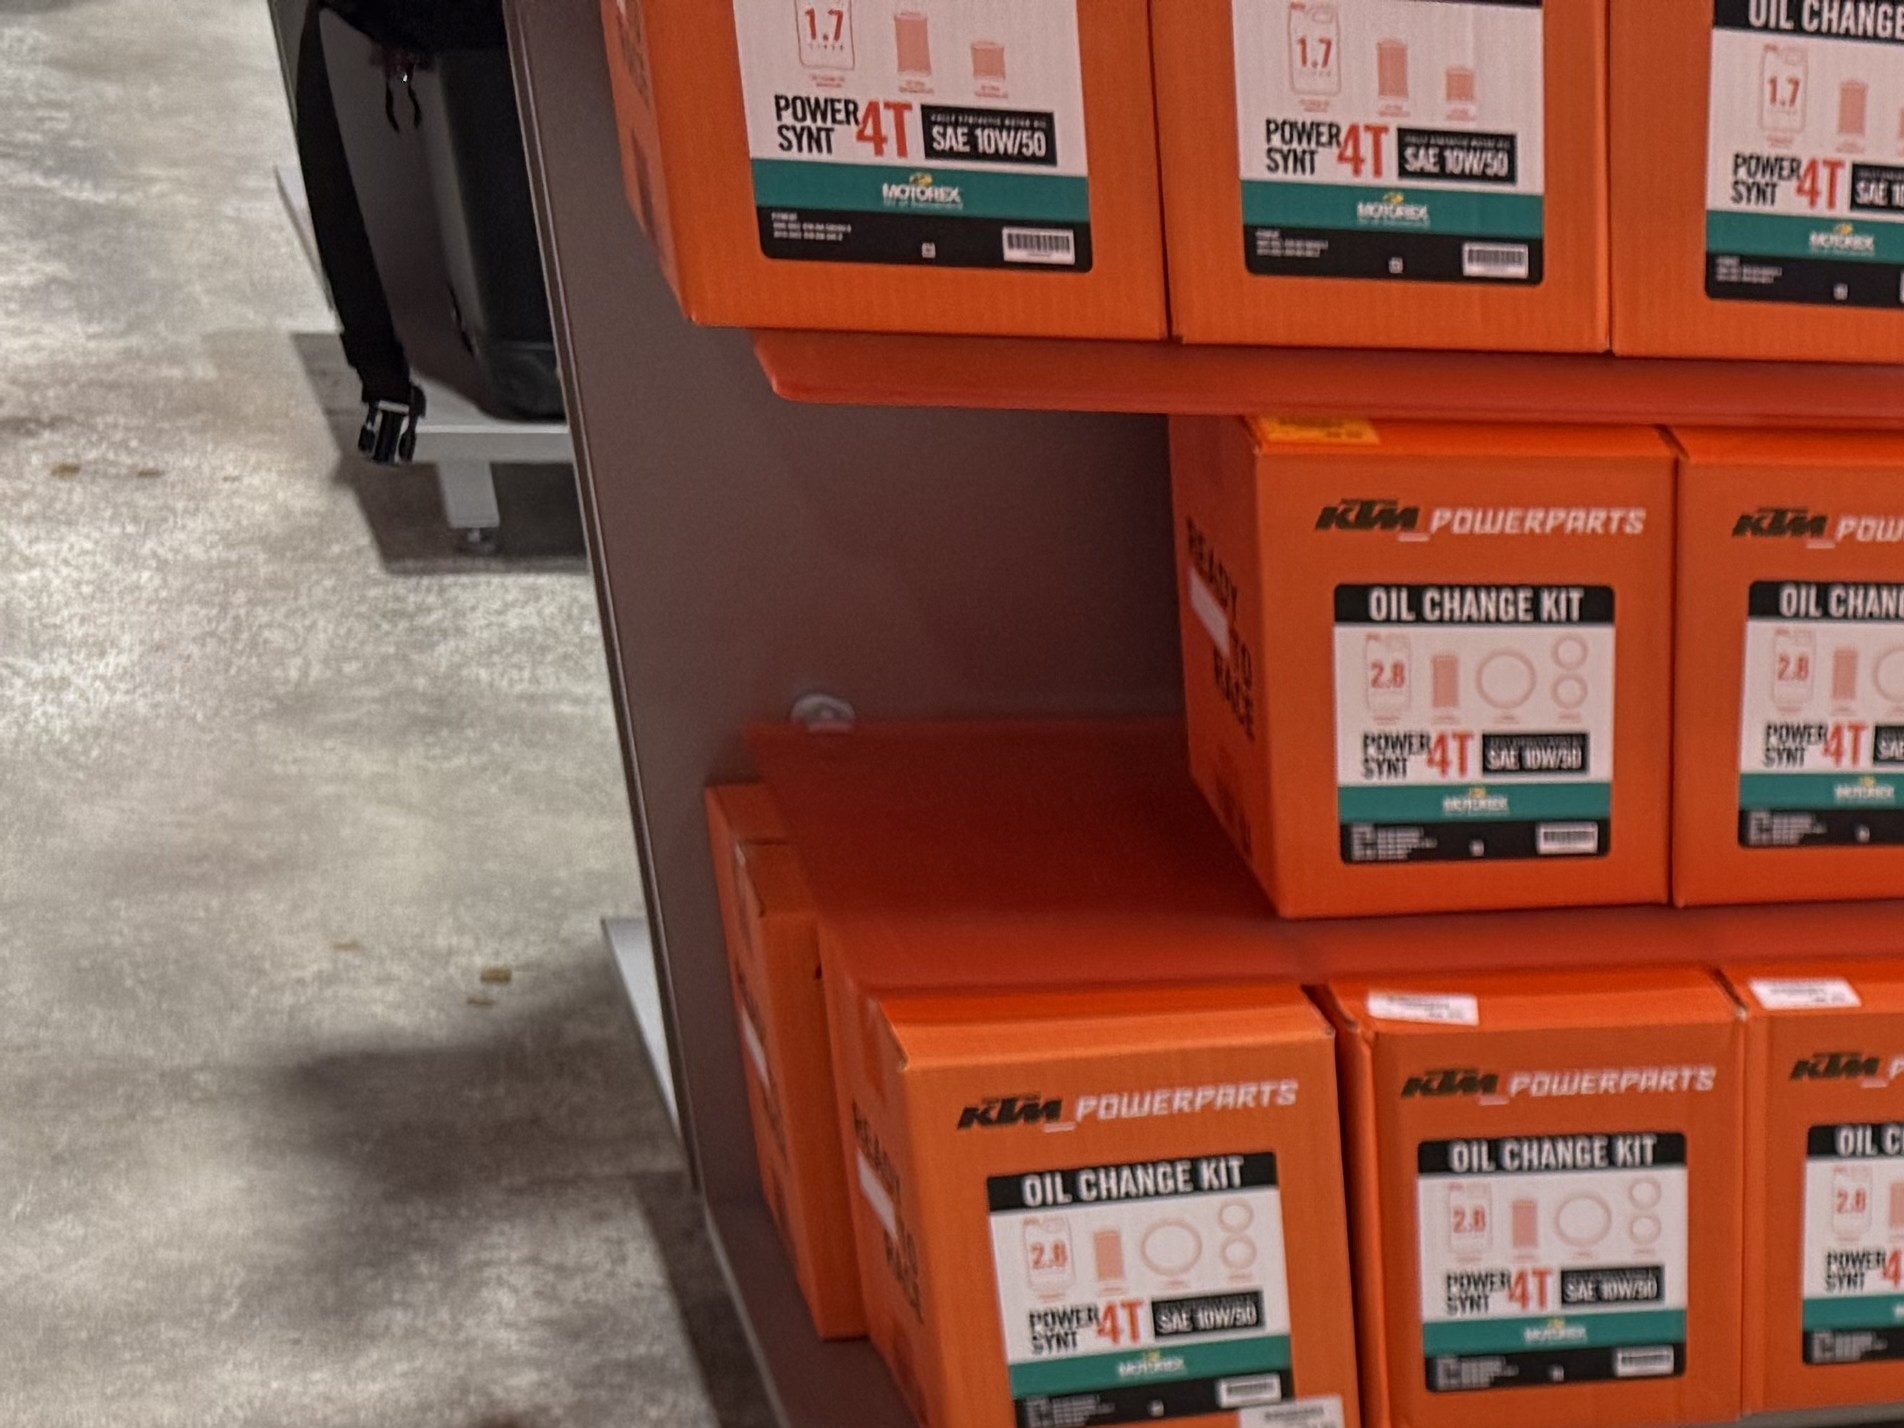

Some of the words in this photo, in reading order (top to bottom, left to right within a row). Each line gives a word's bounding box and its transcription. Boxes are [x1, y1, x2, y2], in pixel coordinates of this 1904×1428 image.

[805, 8, 844, 42] 1.7
[1749, 0, 1794, 29] OIL
[1297, 37, 1333, 68] 1.7
[1768, 76, 1800, 108] 1.7
[775, 95, 860, 126] POWER
[778, 124, 835, 154] SYNT
[857, 99, 912, 158] 4T
[932, 125, 970, 152] SAE
[974, 127, 1046, 157] 10W/50
[1265, 118, 1341, 148] POWER
[1266, 149, 1318, 175] SYNT
[1337, 123, 1388, 178] 4T
[1404, 147, 1439, 173] SAE
[1443, 149, 1508, 178] 10W/50
[1733, 153, 1802, 181] POWER
[882, 183, 961, 203] MOTOREX
[1732, 180, 1779, 206] SYNT
[1796, 158, 1845, 210] 4T
[1855, 180, 1888, 206] SAE
[1314, 498, 1420, 531] KTM
[1429, 507, 1646, 535] POWERPARTS
[1732, 506, 1828, 538] KTM
[1368, 587, 1416, 621] OIL
[1422, 588, 1534, 622] CHANGE
[1540, 588, 1585, 622] KIT
[1778, 583, 1822, 618] OIL
[1370, 661, 1405, 690] 2.8
[1363, 732, 1430, 756] POWER
[1765, 722, 1828, 747] POWER
[1822, 722, 1867, 768] 4T
[1362, 756, 1408, 780] SYNT
[1427, 731, 1475, 778] 4T
[1401, 1067, 1499, 1099] KTM
[1508, 1065, 1717, 1098] POWERPARTS
[1790, 1052, 1881, 1081] KTM
[957, 1093, 1062, 1130] KTM
[1074, 1079, 1299, 1123] POWERPARTS
[1450, 1140, 1496, 1172] OIL
[1502, 1135, 1609, 1171] CHANGE
[1613, 1134, 1657, 1167] KIT
[1836, 1126, 1878, 1156] OIL
[1021, 1172, 1073, 1207] OIL
[1078, 1160, 1194, 1202] CHANGE
[1199, 1155, 1245, 1191] KIT
[1447, 1269, 1511, 1294] POWER
[1508, 1267, 1553, 1310] 4T
[1029, 1303, 1098, 1332] POWER
[1095, 1300, 1144, 1345] 4T
